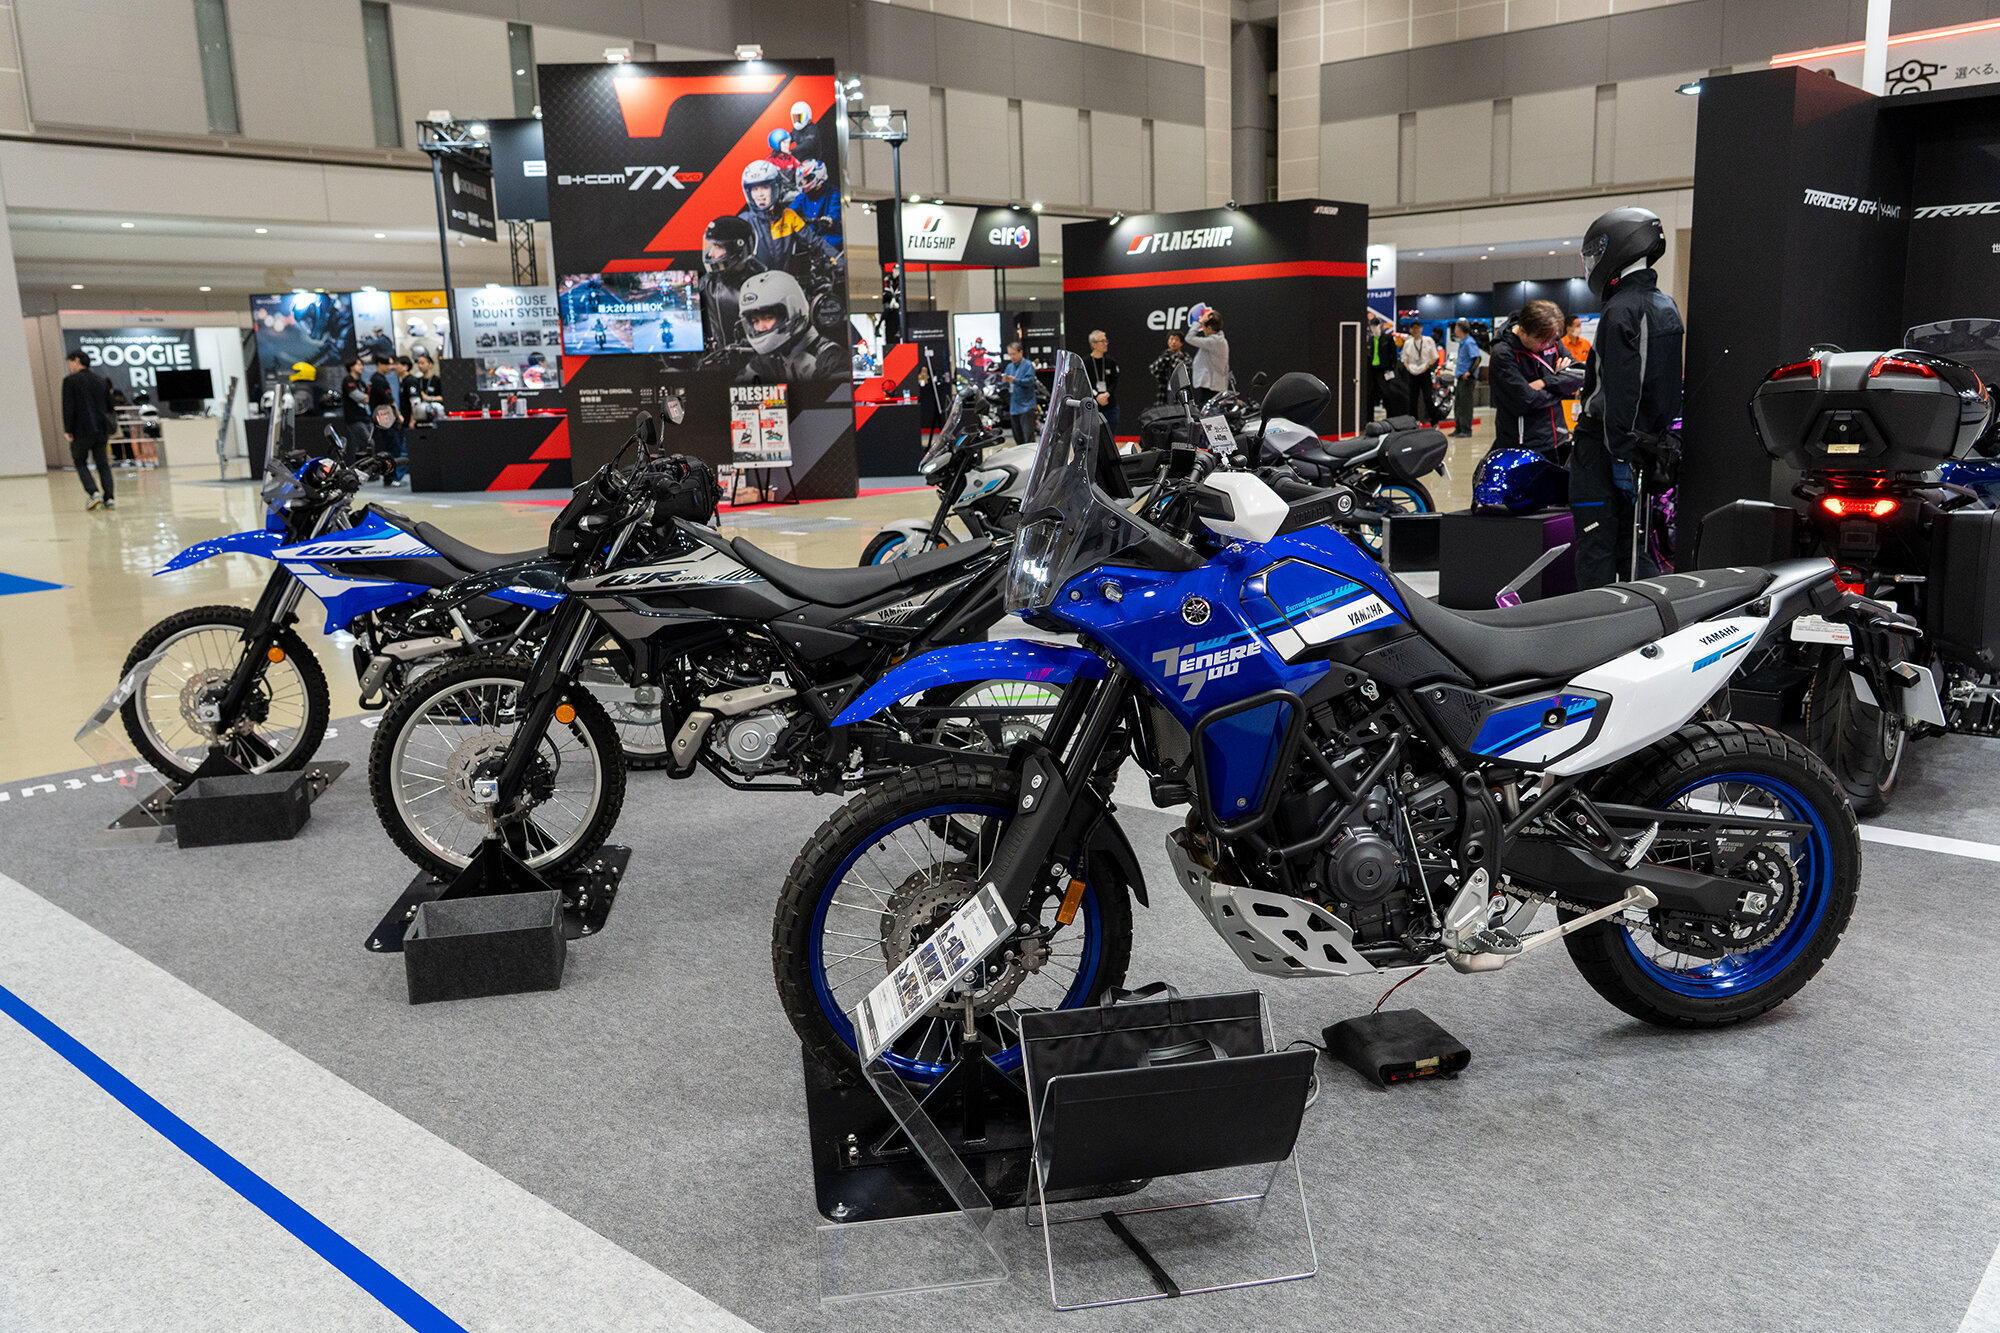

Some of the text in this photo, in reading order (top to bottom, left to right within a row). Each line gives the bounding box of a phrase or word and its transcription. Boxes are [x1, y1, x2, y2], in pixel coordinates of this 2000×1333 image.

[908, 235, 956, 249] FLAGSHIP
[988, 227, 1016, 246] elf
[473, 308, 515, 319] MOUNT
[1147, 307, 1188, 330] elf
[81, 343, 192, 367] BOOGIE
[129, 366, 192, 388] RI
[729, 385, 786, 401] PRESENT
[296, 545, 376, 556] WR
[877, 601, 914, 620] YAMAHA
[1347, 602, 1384, 626] YAMAHA
[1699, 625, 1740, 646] YAMAHA
[1178, 661, 1240, 703] 700
